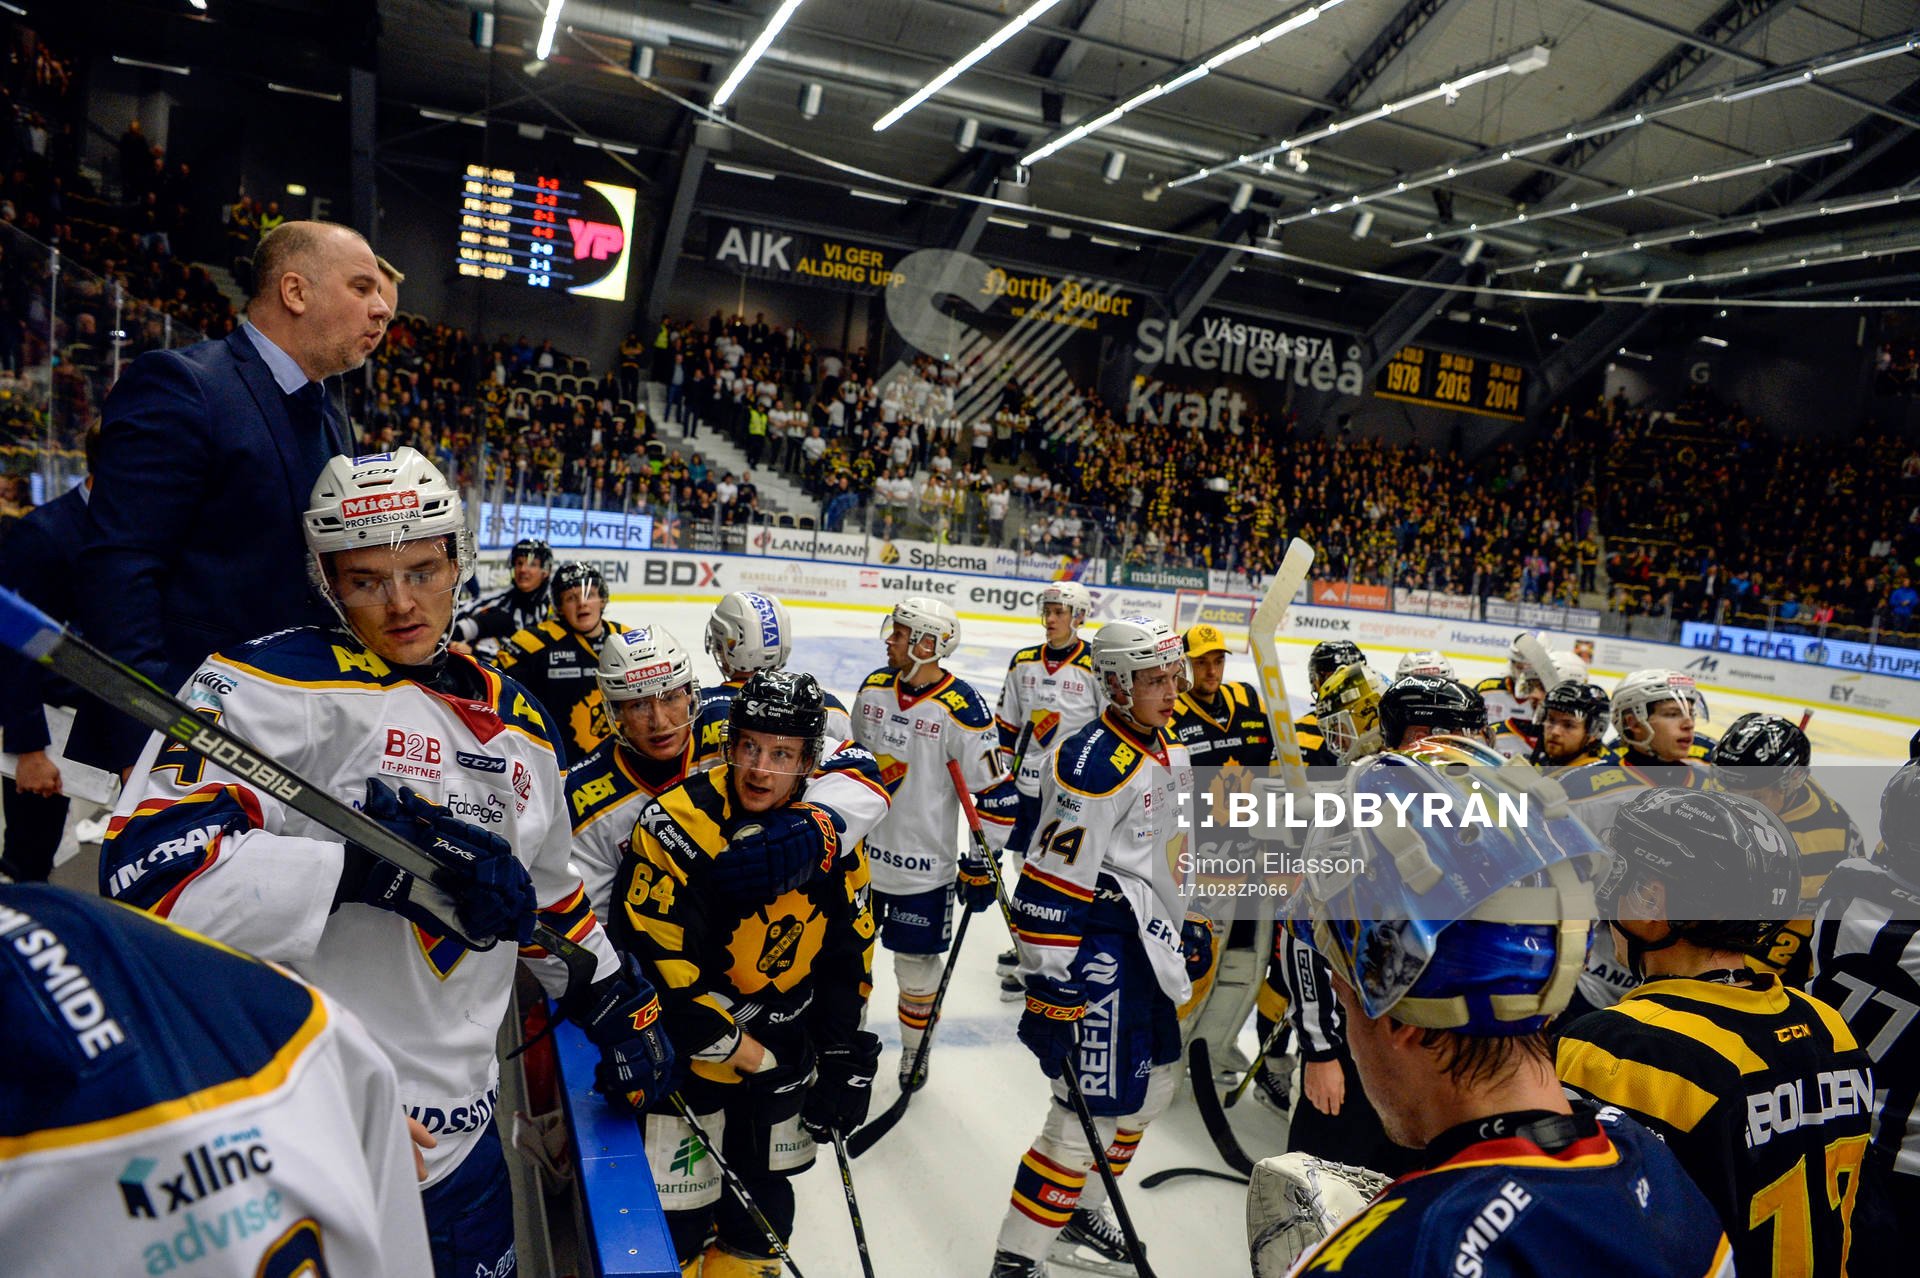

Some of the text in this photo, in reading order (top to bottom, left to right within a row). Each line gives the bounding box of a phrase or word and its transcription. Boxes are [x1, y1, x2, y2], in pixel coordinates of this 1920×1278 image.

[716, 227, 793, 271] AIK
[824, 243, 884, 268] VI GER
[796, 257, 906, 288] ALDRIG UPP
[980, 267, 1053, 304] North
[1203, 317, 1289, 354] VÄSTRA
[1387, 362, 1421, 394] 1978
[1435, 370, 1471, 402] 2013
[1126, 380, 1247, 435] Kraft
[1485, 381, 1520, 411] 2014
[351, 468, 398, 480] CCM
[344, 494, 417, 515] Miele
[346, 510, 421, 528] PROFESSIONAL
[910, 548, 987, 571] Specma
[644, 560, 722, 588] BDX
[881, 575, 957, 595] valutec
[1131, 571, 1204, 588] martinsons
[626, 663, 672, 683] Miele
[1830, 685, 1854, 702] EY
[385, 729, 441, 764] B2B
[191, 729, 302, 801] RIBCOR
[382, 761, 441, 780] IT-PARTNER
[458, 754, 505, 770] CCM
[448, 794, 503, 823] Fabege
[1675, 808, 1694, 821] Kraft
[1680, 802, 1716, 823] Skellefteå
[432, 837, 476, 861] TACKS
[656, 830, 676, 851] Kraft
[664, 824, 698, 860] Skellefteå
[627, 862, 675, 914] 64
[1771, 888, 1787, 905] 17
[14, 929, 125, 1059] SMIDE
[1080, 1001, 1110, 1096] REFIX
[144, 1190, 284, 1276] advise
